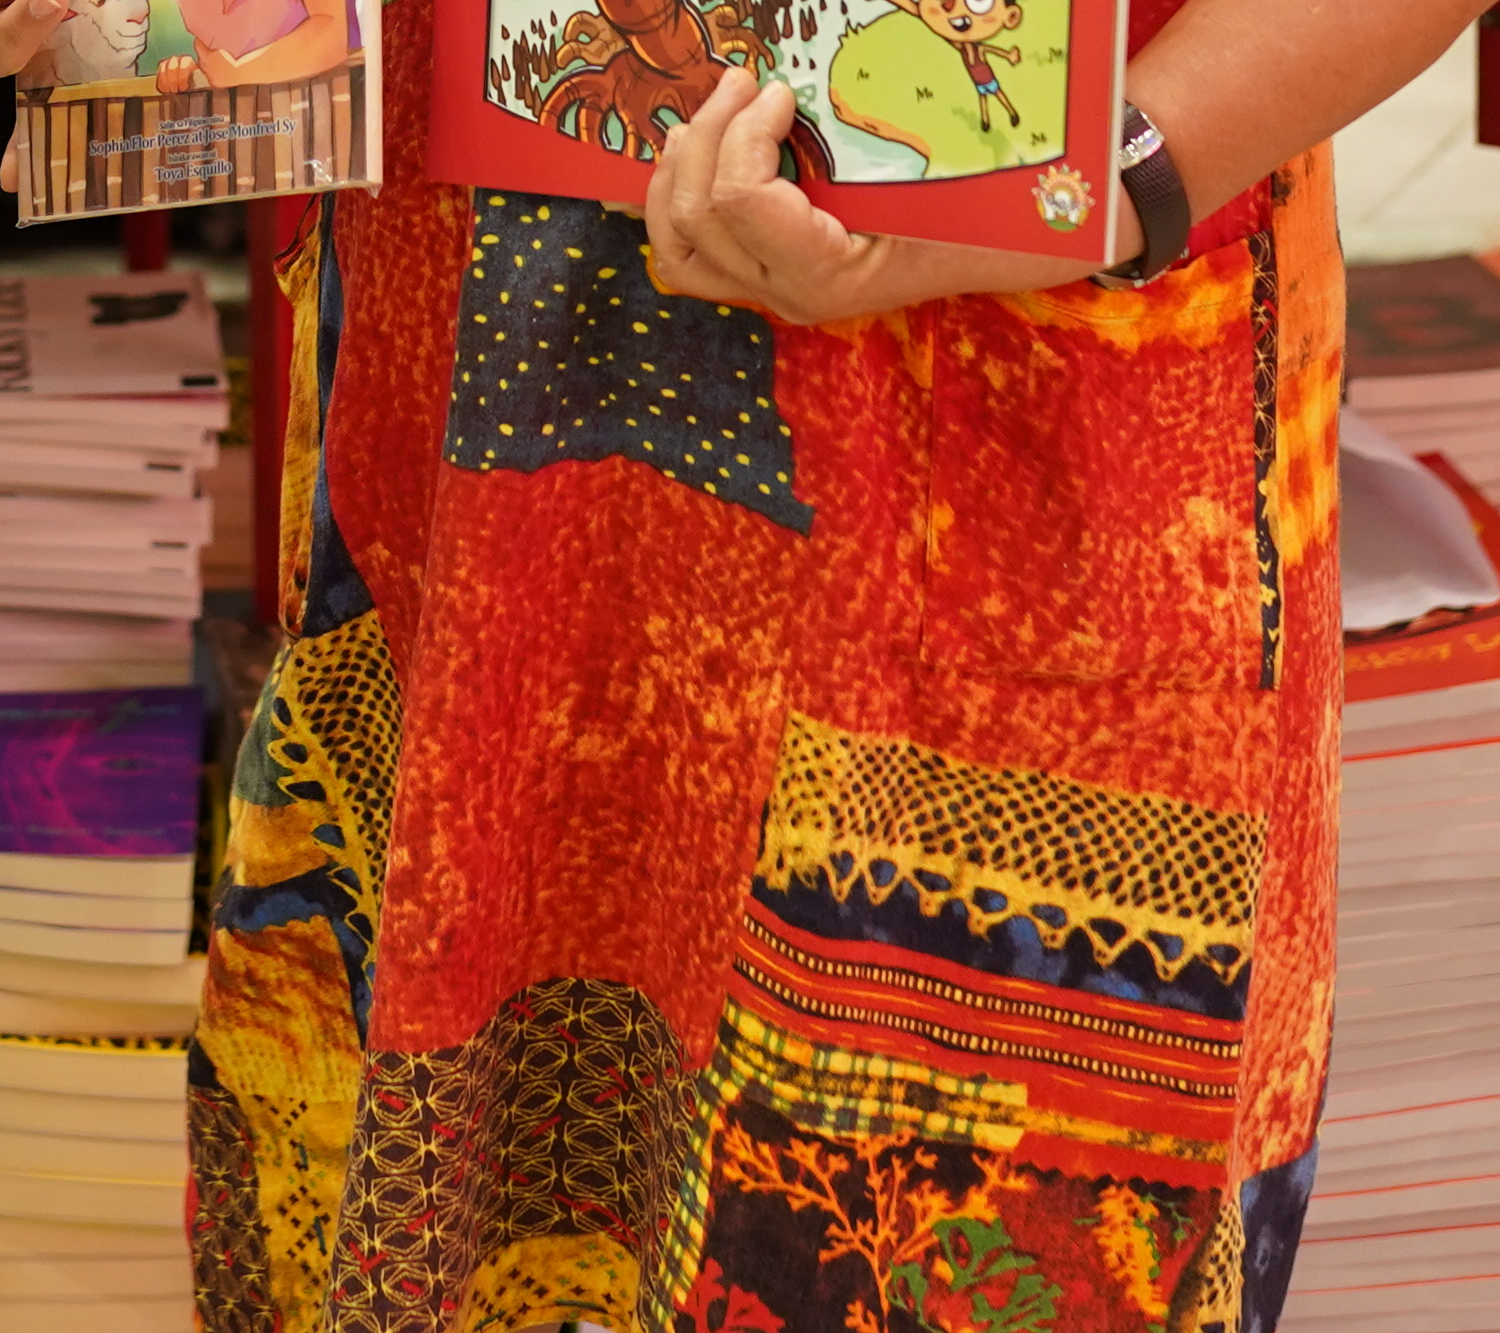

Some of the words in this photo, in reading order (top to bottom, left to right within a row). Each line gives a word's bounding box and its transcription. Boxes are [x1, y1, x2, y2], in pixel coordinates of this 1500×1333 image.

[89, 136, 132, 157] Sophia
[131, 133, 156, 153] Flor
[157, 131, 190, 148] Perez
[191, 130, 203, 145] at
[203, 127, 230, 146] Jose
[230, 119, 282, 139] Monfred
[282, 118, 298, 136] Sy
[155, 167, 186, 187] Toya
[186, 159, 234, 181] Esquillo
